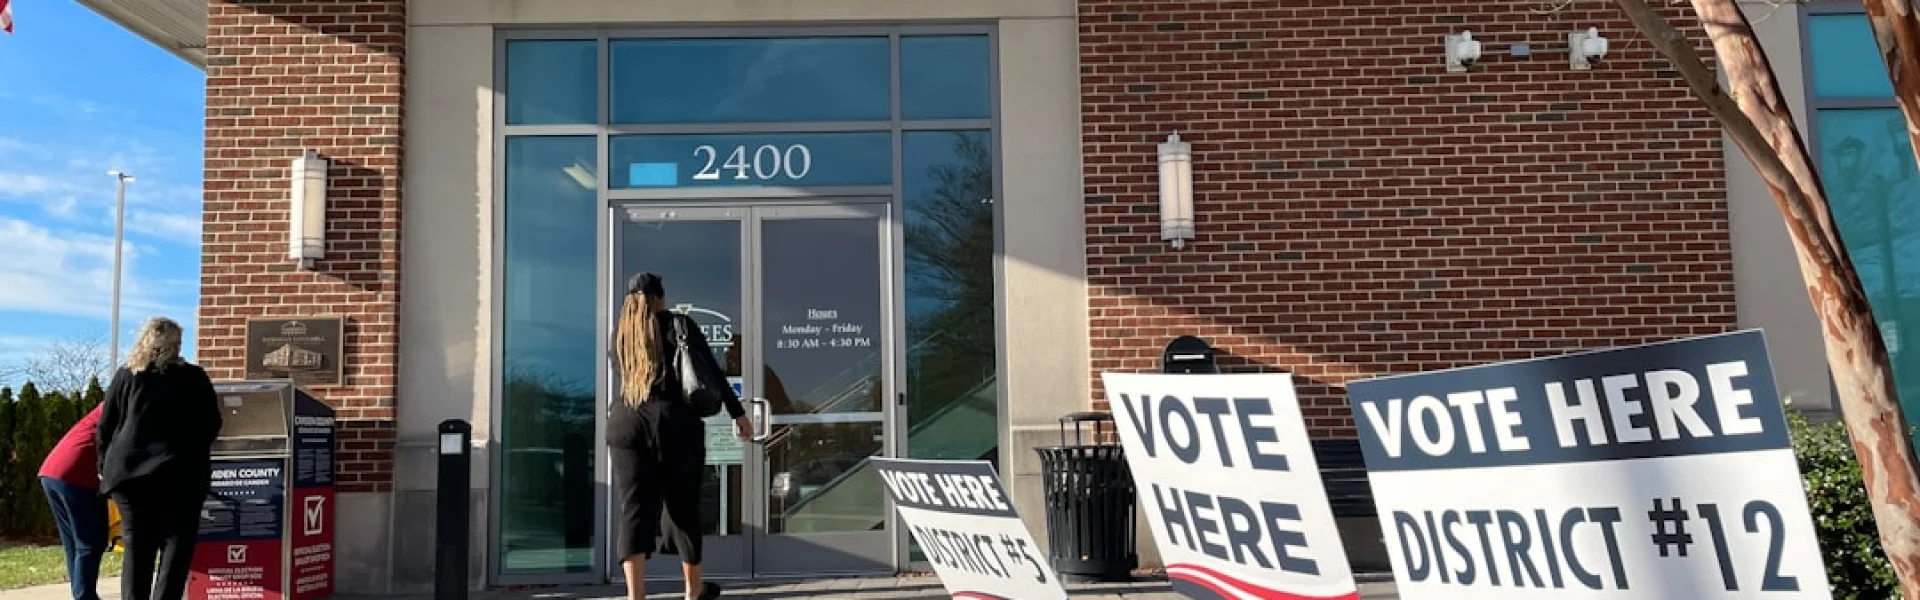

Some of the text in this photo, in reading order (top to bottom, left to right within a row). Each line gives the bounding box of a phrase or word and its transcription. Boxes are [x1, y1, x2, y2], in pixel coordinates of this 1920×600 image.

[691, 143, 811, 181] 2400
[781, 324, 822, 336] Monday
[831, 322, 863, 334] Friday
[806, 308, 838, 320] Hours
[801, 338, 820, 349] AM
[829, 338, 852, 347] 4:30
[854, 336, 871, 347] PM
[1361, 360, 1764, 458] VOTE HERE
[1119, 392, 1290, 472] VOTE
[238, 466, 280, 478] COUNTY
[879, 468, 1009, 511] VOTE HERE
[1151, 482, 1321, 577] HERE
[1392, 497, 1801, 592] DISTRICT #12
[913, 524, 1048, 584] DISTRICT #5
